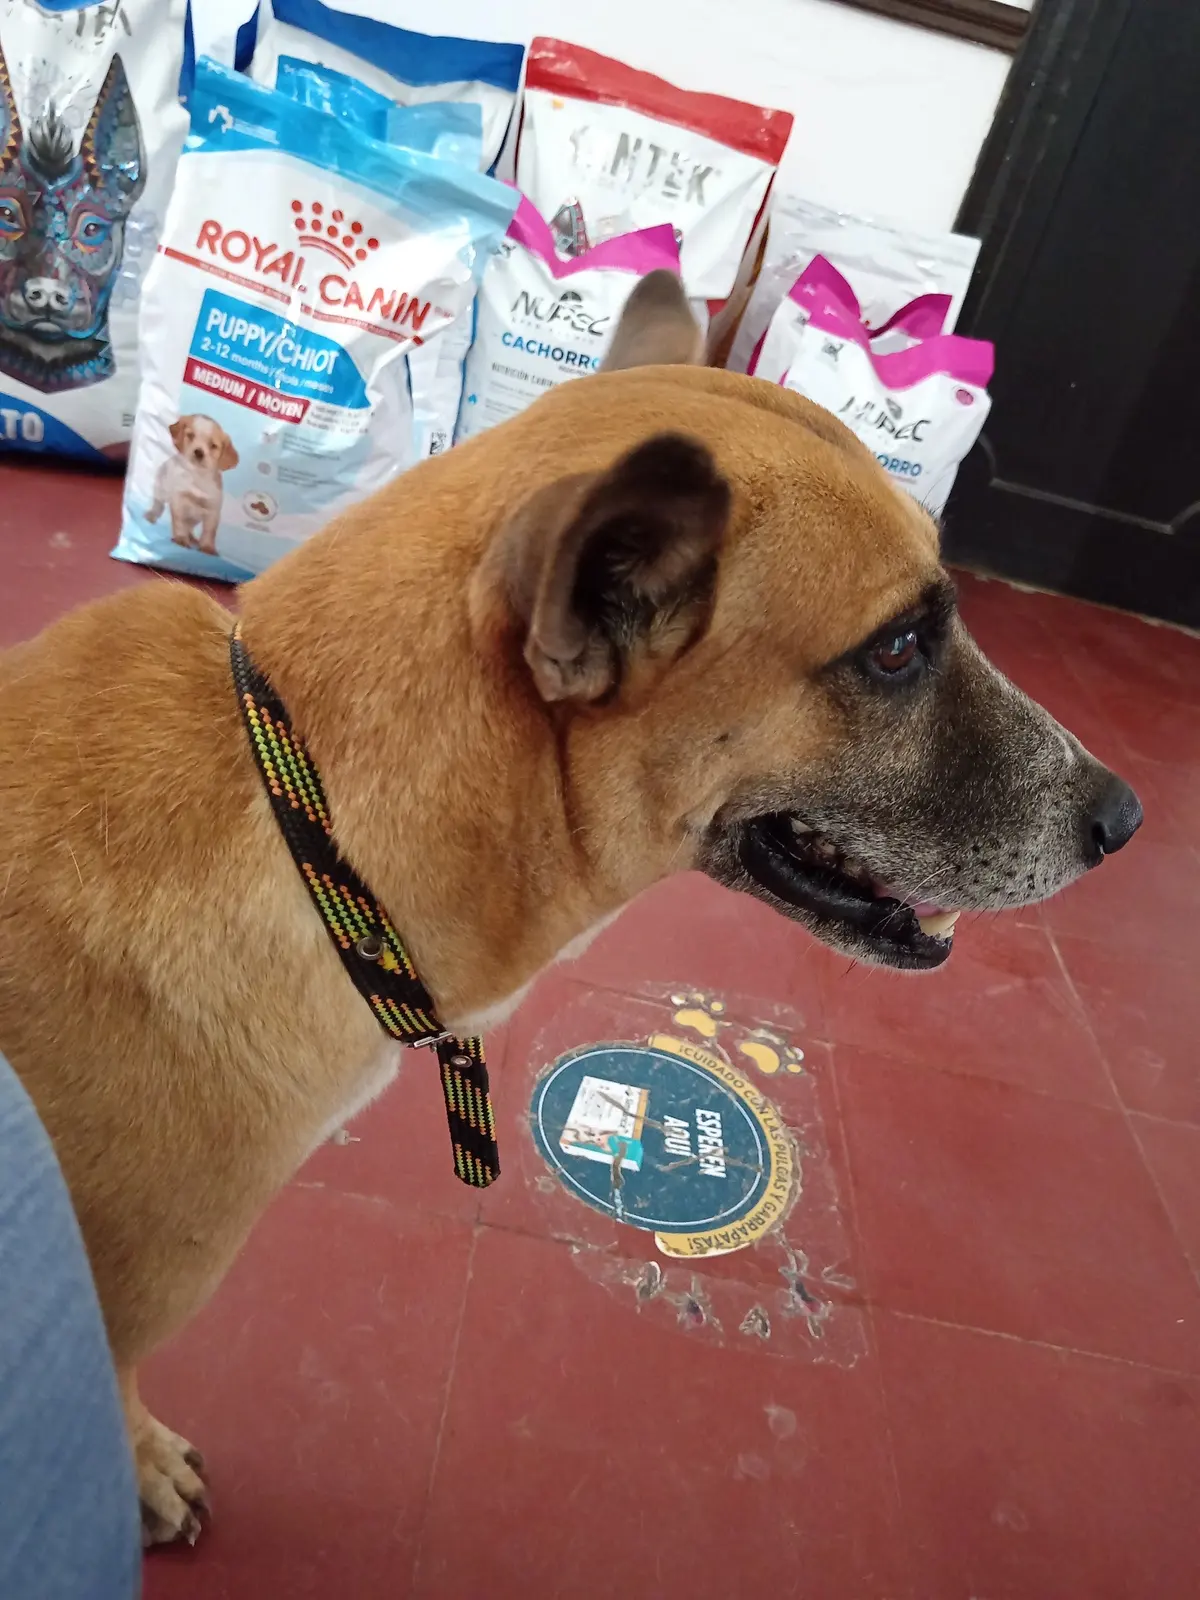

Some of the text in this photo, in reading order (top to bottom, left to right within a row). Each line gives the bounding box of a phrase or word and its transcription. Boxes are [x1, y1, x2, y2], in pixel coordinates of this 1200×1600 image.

[196, 220, 307, 293] ROYAL
[319, 274, 431, 330] CANIN
[201, 336, 230, 359] 2-12
[193, 365, 246, 400] MEDIUM
[257, 388, 304, 419] MOYEN
[0, 408, 45, 443] TO
[871, 452, 923, 478] ORRO
[695, 1108, 727, 1179] ESPEREN
[773, 1142, 790, 1193] PULGAS
[769, 1192, 784, 1205] Y
